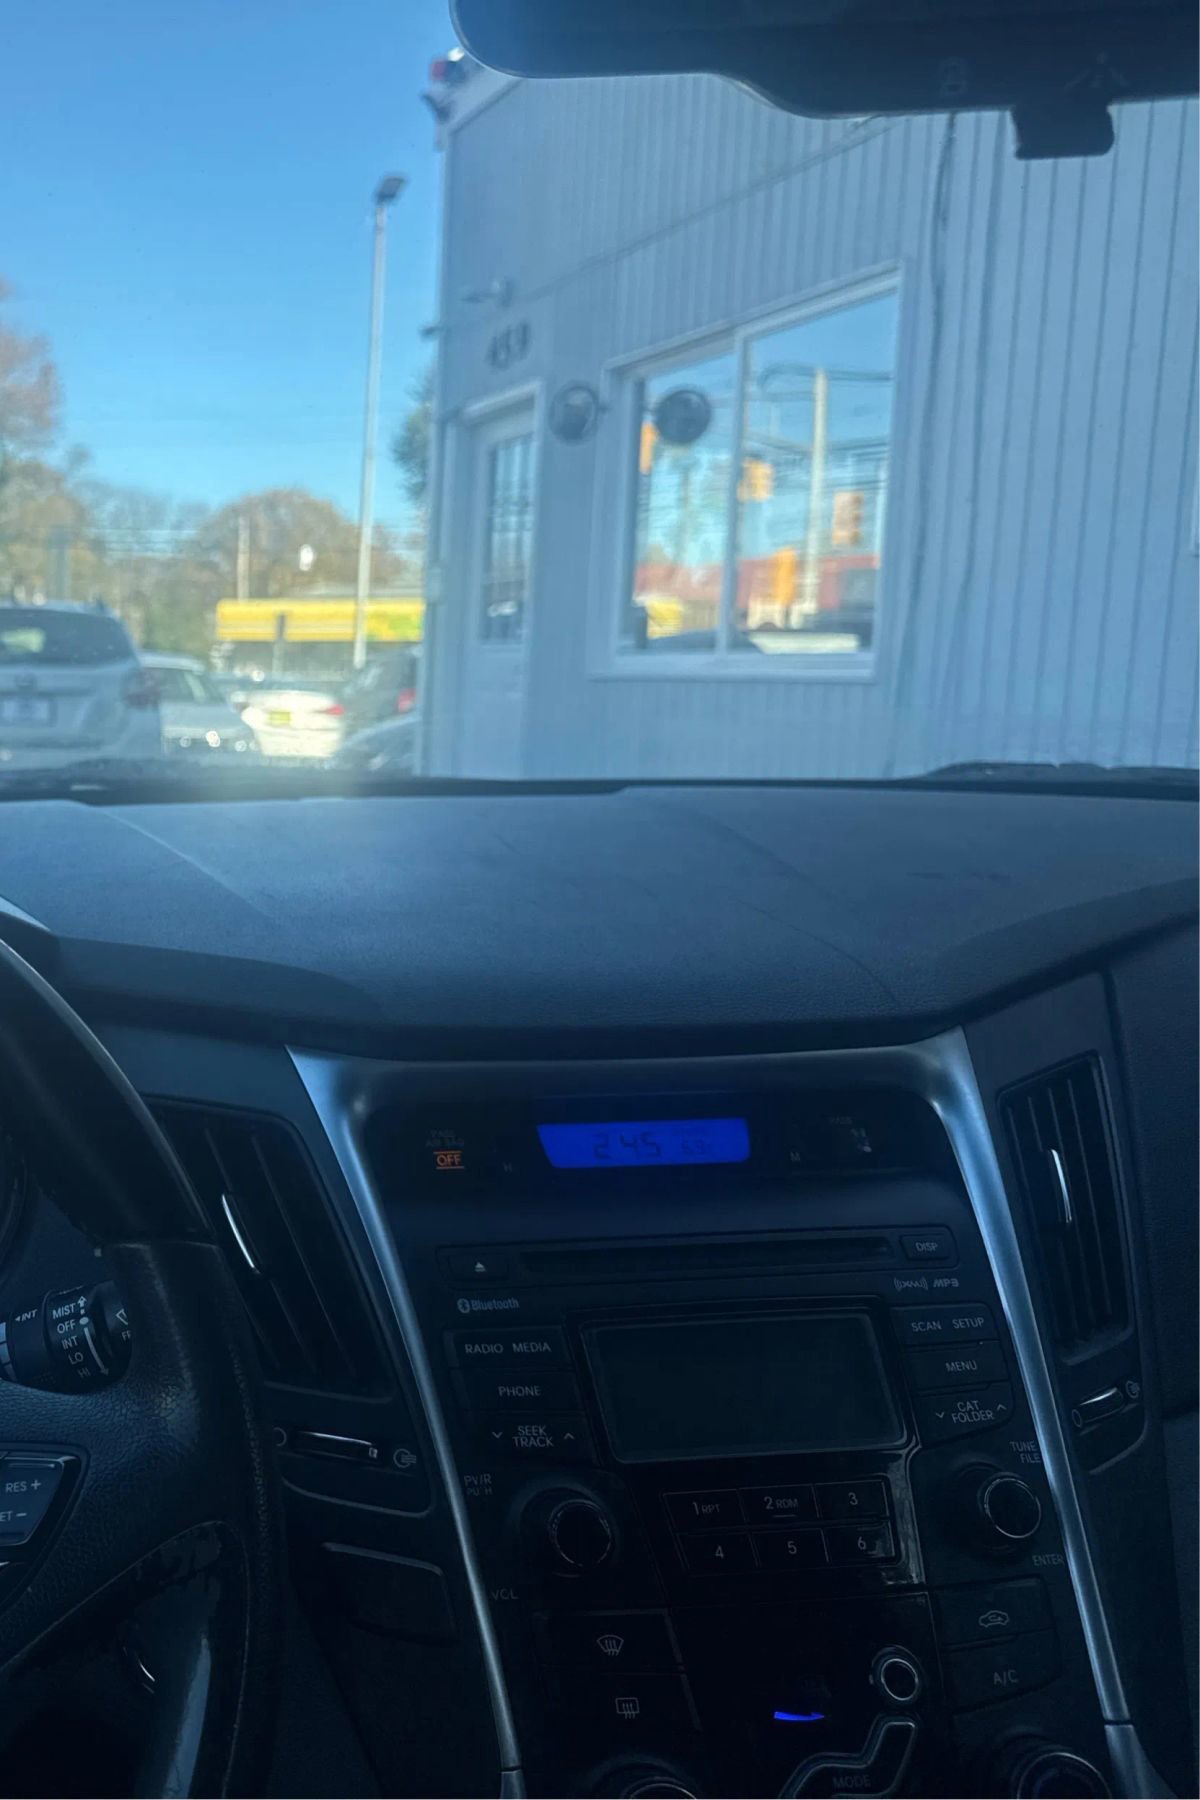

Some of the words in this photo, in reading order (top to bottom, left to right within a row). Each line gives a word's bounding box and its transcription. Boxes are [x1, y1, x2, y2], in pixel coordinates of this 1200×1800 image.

[436, 1154, 462, 1166] OFF
[915, 1242, 938, 1251] DISP
[933, 1278, 960, 1288] MP3
[52, 1302, 76, 1320] MIST
[472, 1298, 519, 1311] Bluetooth
[21, 1309, 38, 1321] INT
[57, 1320, 76, 1334] OFF
[911, 1321, 942, 1332] SCAN
[952, 1317, 984, 1329] SETUP
[61, 1335, 78, 1350] INT
[464, 1343, 504, 1355] RADIO
[512, 1341, 552, 1353] MEDIA
[68, 1352, 84, 1365] LO
[78, 1366, 91, 1378] HI
[945, 1360, 978, 1372] MENU
[498, 1385, 543, 1397] PHONE
[957, 1400, 980, 1412] CAT
[951, 1410, 995, 1423] FOLDER
[517, 1425, 547, 1437] SEEK
[512, 1436, 554, 1448] TRACK
[1009, 1440, 1037, 1453] TUNE
[5, 1481, 27, 1493] RES
[764, 1496, 774, 1510] 2
[776, 1499, 798, 1510] RDM
[848, 1492, 858, 1506] 3
[693, 1501, 700, 1516] 1
[701, 1503, 720, 1514] RPT
[787, 1540, 797, 1555] 5
[857, 1536, 867, 1550] 6
[715, 1545, 725, 1559] 4
[1032, 1553, 1064, 1567] ENTER
[993, 1669, 1020, 1686] A/C
[832, 1775, 873, 1790] MODE
